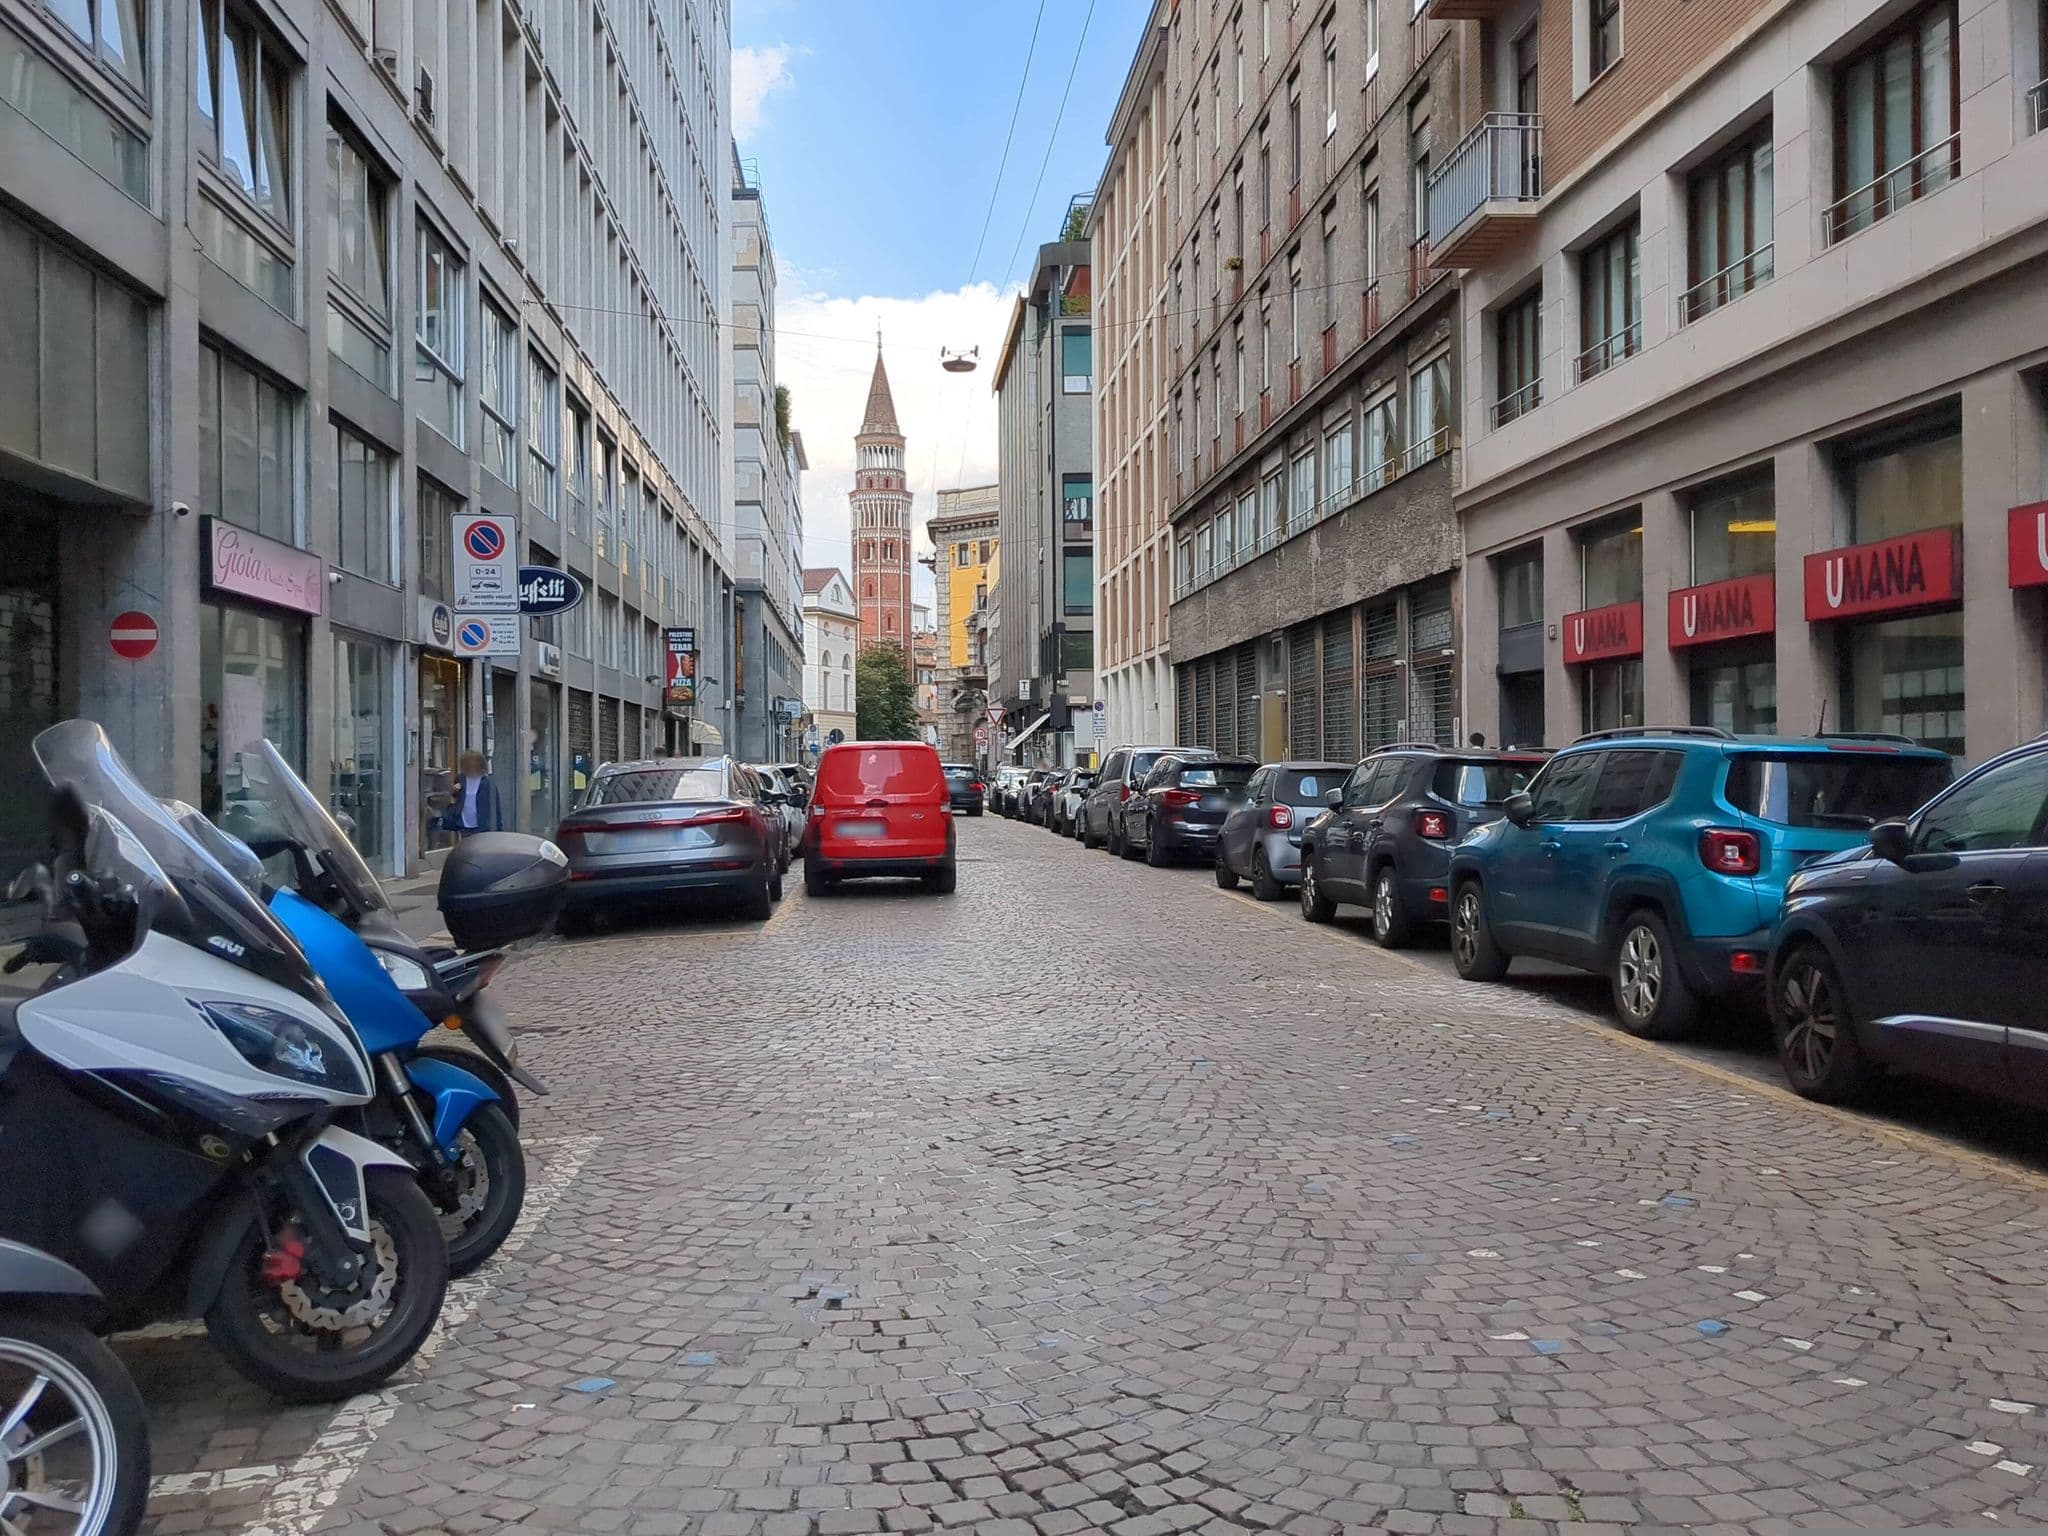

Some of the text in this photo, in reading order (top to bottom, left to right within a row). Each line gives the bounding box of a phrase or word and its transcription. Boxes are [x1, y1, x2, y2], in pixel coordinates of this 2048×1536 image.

[215, 527, 261, 585] Gioia
[520, 577, 565, 605] uffetti
[1826, 541, 1925, 609] UMANA
[1684, 586, 1755, 638] UMANA
[669, 643, 693, 651] KEBAB
[1574, 610, 1629, 655] UMANA
[671, 678, 692, 686] PIZZA
[207, 936, 245, 957] GIVI
